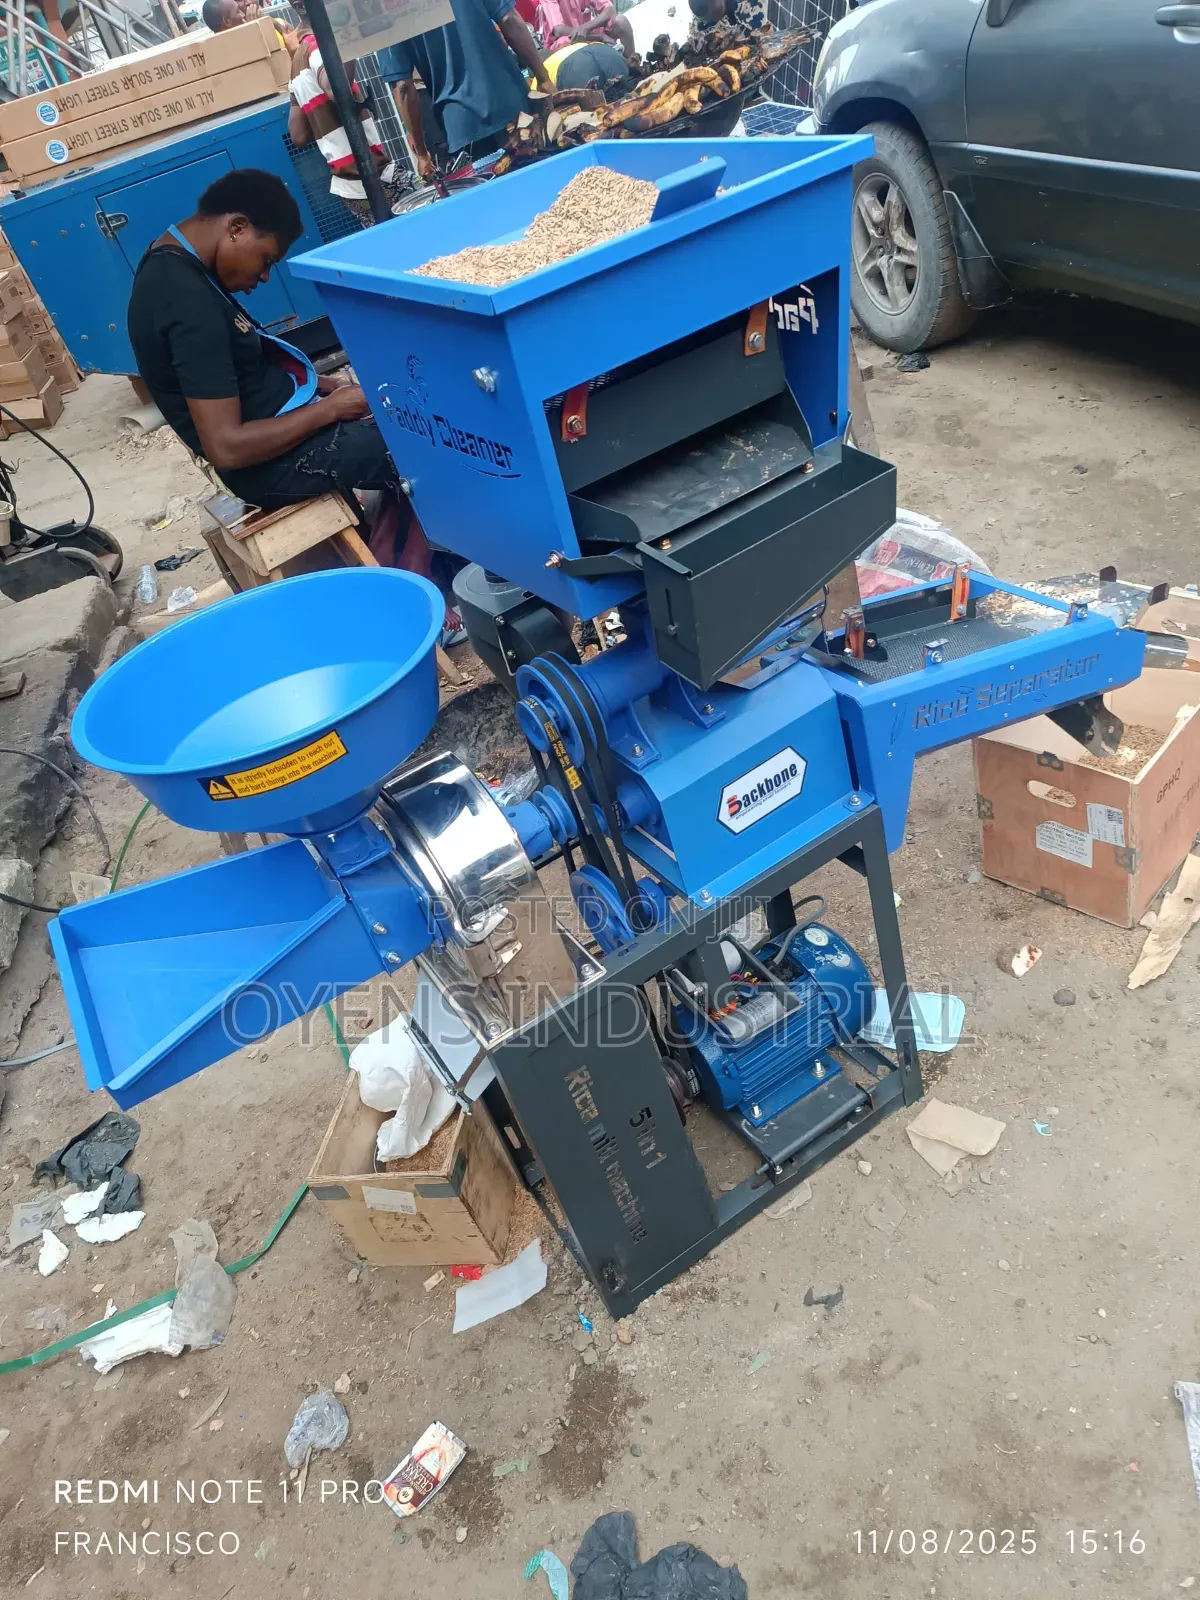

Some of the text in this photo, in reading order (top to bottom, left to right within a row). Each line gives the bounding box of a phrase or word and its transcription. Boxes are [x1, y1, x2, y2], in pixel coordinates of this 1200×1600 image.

[56, 52, 206, 113] ALL IN ONE SOLAR STREET LIGHT
[65, 90, 215, 150] ALL IN ONE SOLAR STREET LIGHT
[381, 396, 514, 471] Paddy Cleaner
[912, 653, 1101, 732] Rice Separator
[230, 738, 335, 785] It is strictly forbidden to reach out
[237, 784, 250, 794] and
[250, 780, 267, 792] hard
[266, 774, 288, 789] things
[287, 770, 300, 781] into
[300, 764, 312, 774] the
[312, 748, 338, 768] machine
[726, 763, 798, 818] Backbone
[564, 1064, 648, 1245] Rice mill machine
[405, 1464, 434, 1493] CREAM
